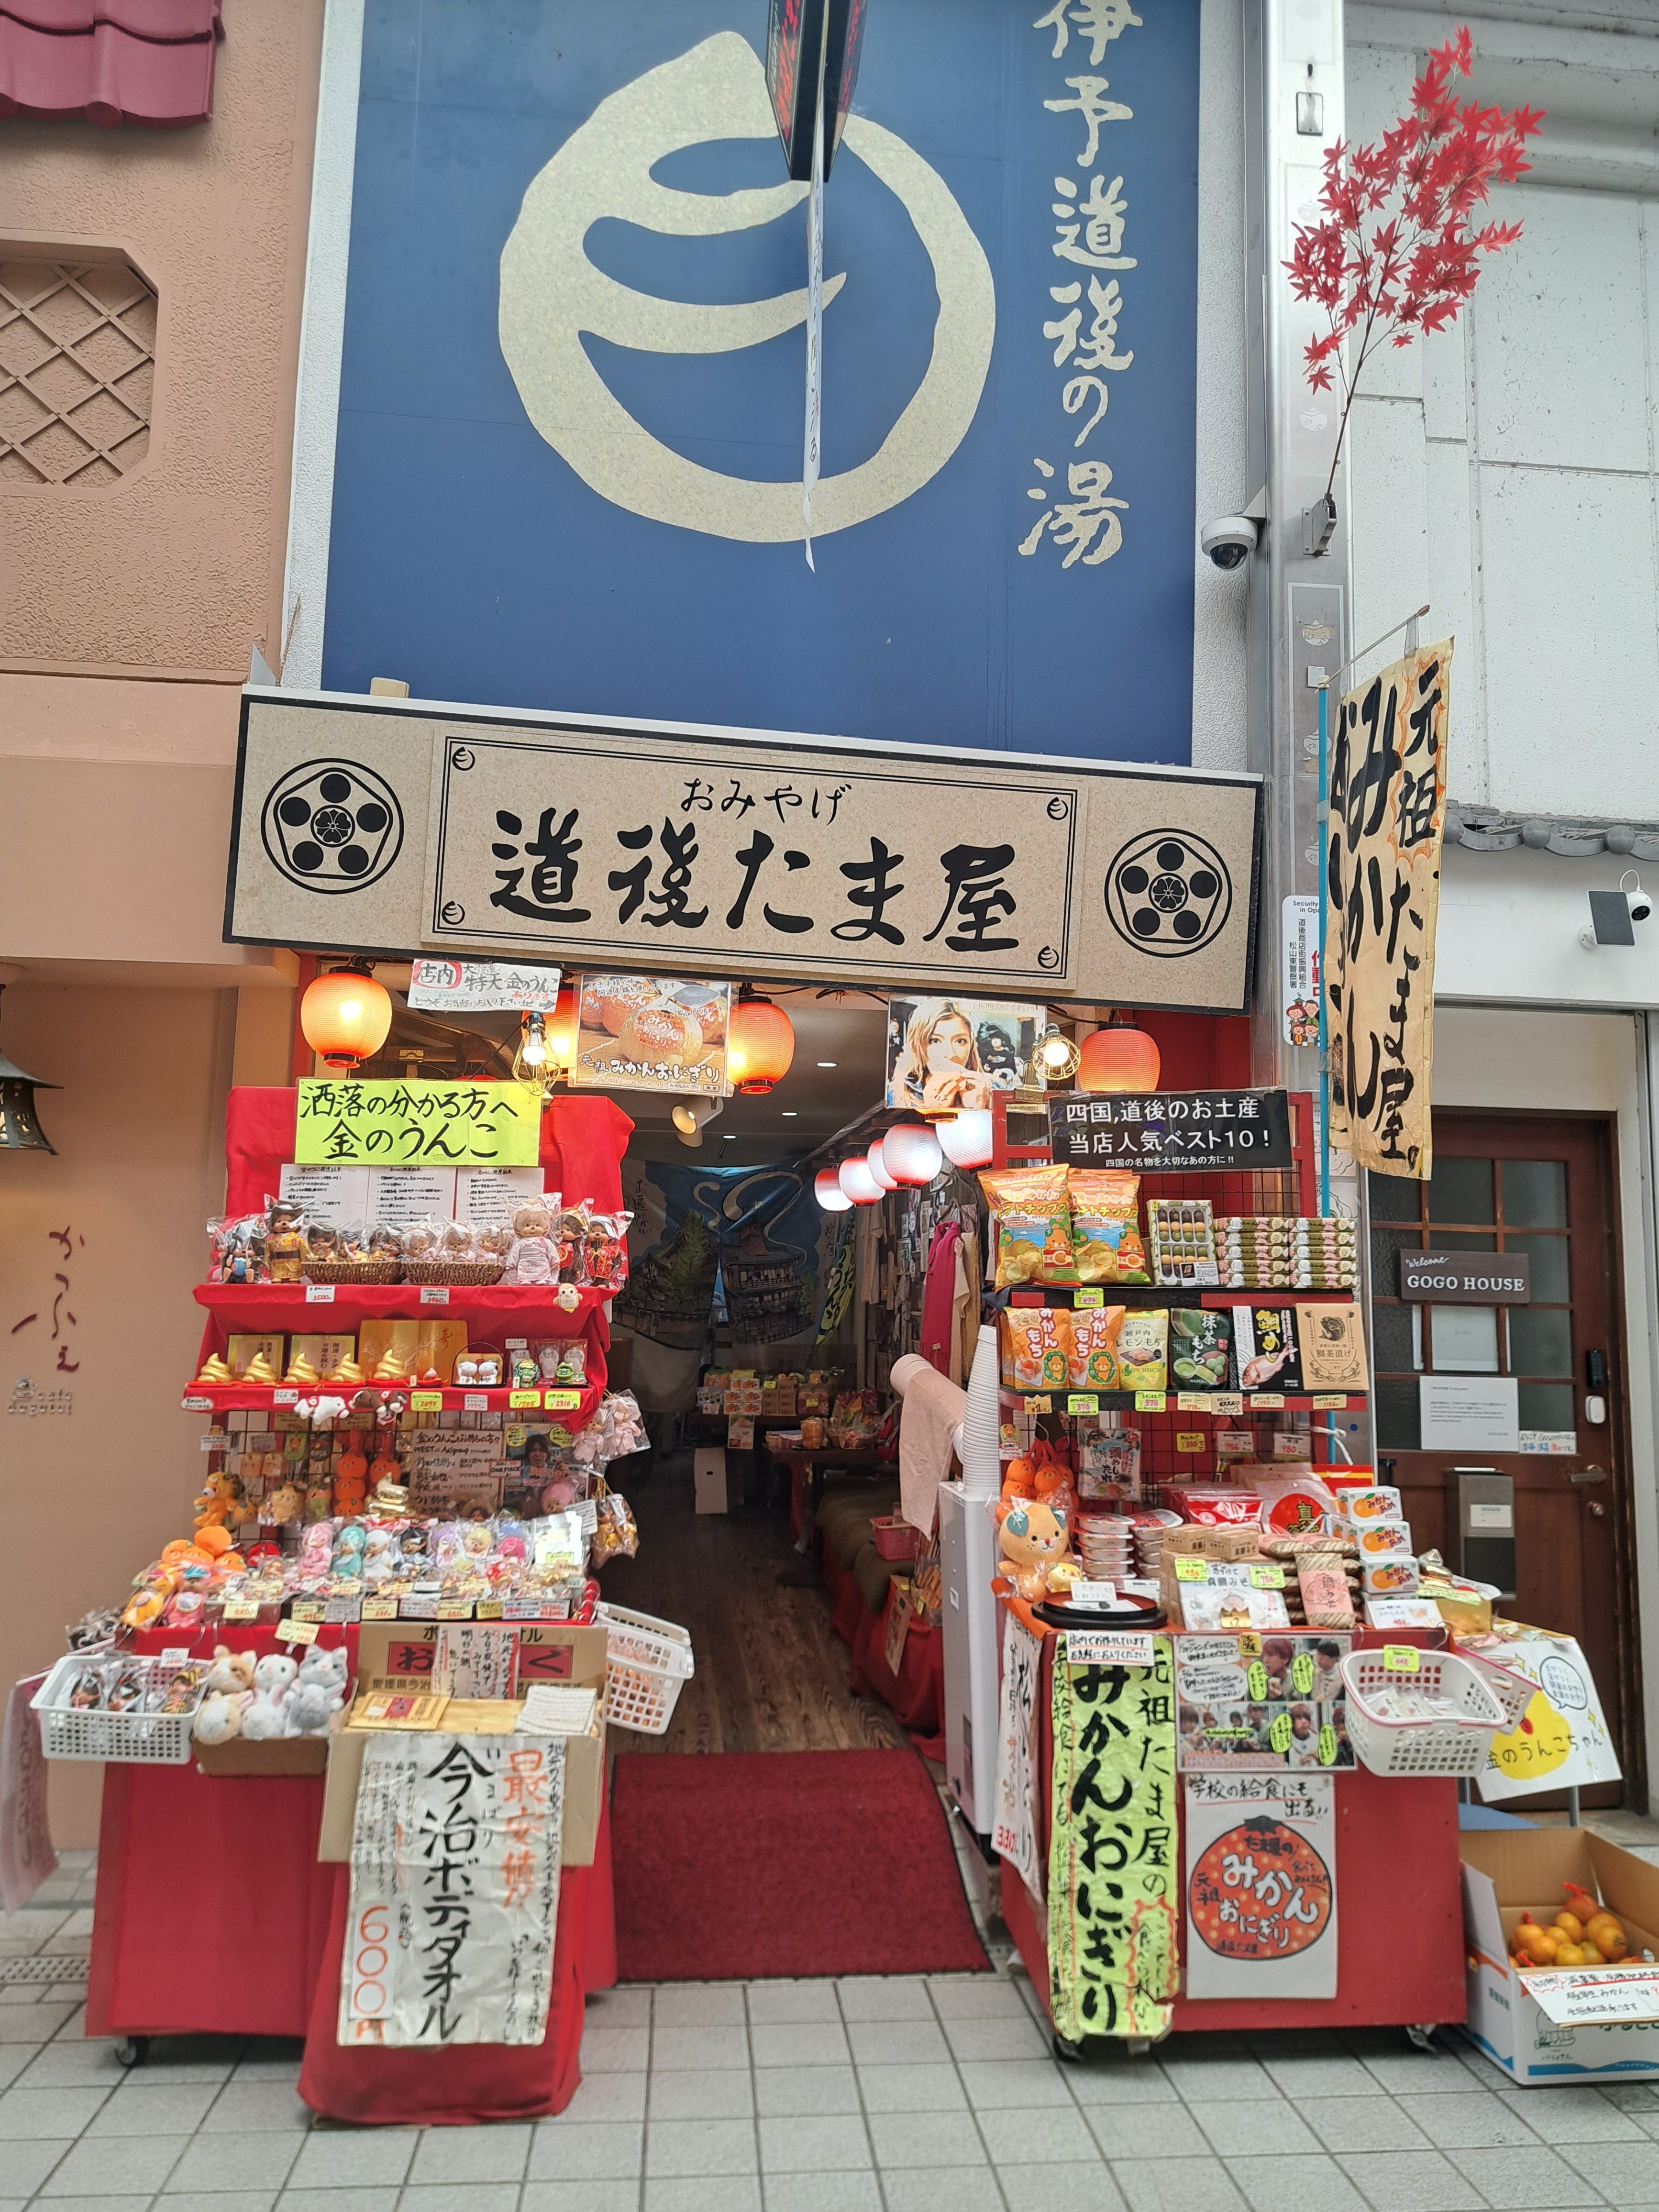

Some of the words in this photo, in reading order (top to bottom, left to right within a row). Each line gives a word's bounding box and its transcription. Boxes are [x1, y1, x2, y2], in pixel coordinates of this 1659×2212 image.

[1018, 0, 1144, 568] 伊予道後の湯
[681, 778, 852, 826] おみやげ
[490, 807, 1019, 952] 道後たま屋
[420, 963, 454, 984] 店内
[1298, 918, 1306, 989] 道後商店街振興組合
[647, 1014, 680, 1041] みかん
[322, 1118, 498, 1160] 金のうんこ
[1405, 1256, 1450, 1269] Welcome
[1407, 1275, 1458, 1290] GOGO
[1463, 1277, 1525, 1291] HOUSE
[1027, 1328, 1044, 1359] もち
[1040, 1308, 1059, 1349] みかん
[1076, 1328, 1091, 1359] もち
[1091, 1307, 1107, 1349] みかん
[1202, 1314, 1218, 1346] 抹茶
[1191, 1334, 1205, 1365] もち
[1316, 1349, 1351, 1358] 鯛茶漬け
[1072, 1664, 1132, 2032] みかんおにぎり
[417, 1741, 495, 2041] 今治ボディタオル
[1222, 1853, 1319, 1924] みかん
[1218, 1896, 1290, 1949] おにぎり
